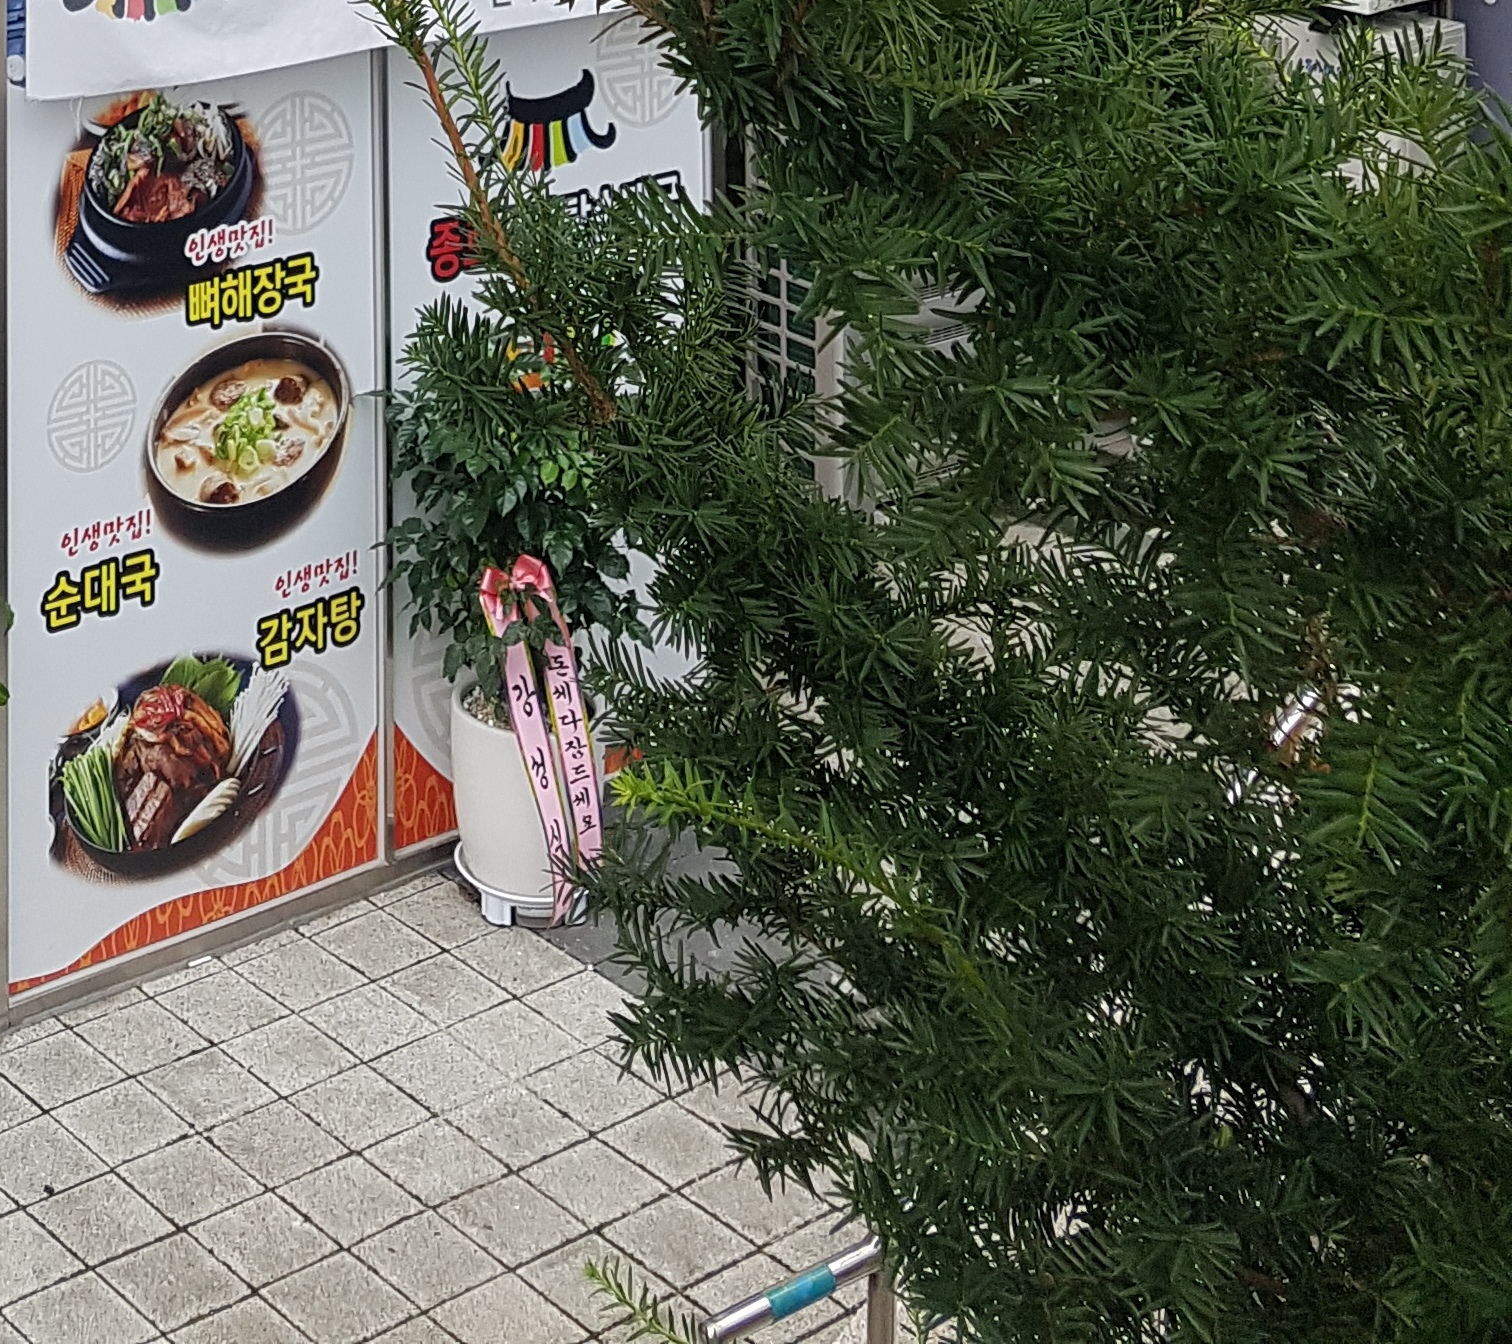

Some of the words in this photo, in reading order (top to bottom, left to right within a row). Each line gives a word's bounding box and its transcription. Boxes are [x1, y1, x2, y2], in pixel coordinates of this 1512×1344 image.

[187, 218, 274, 264] 인생맛집!
[188, 256, 317, 325] 뼈해장국
[60, 508, 152, 556] 인생맛집!
[44, 554, 159, 628] 순대국
[275, 549, 359, 599] 인생맛집!
[258, 594, 364, 666] 감자탕
